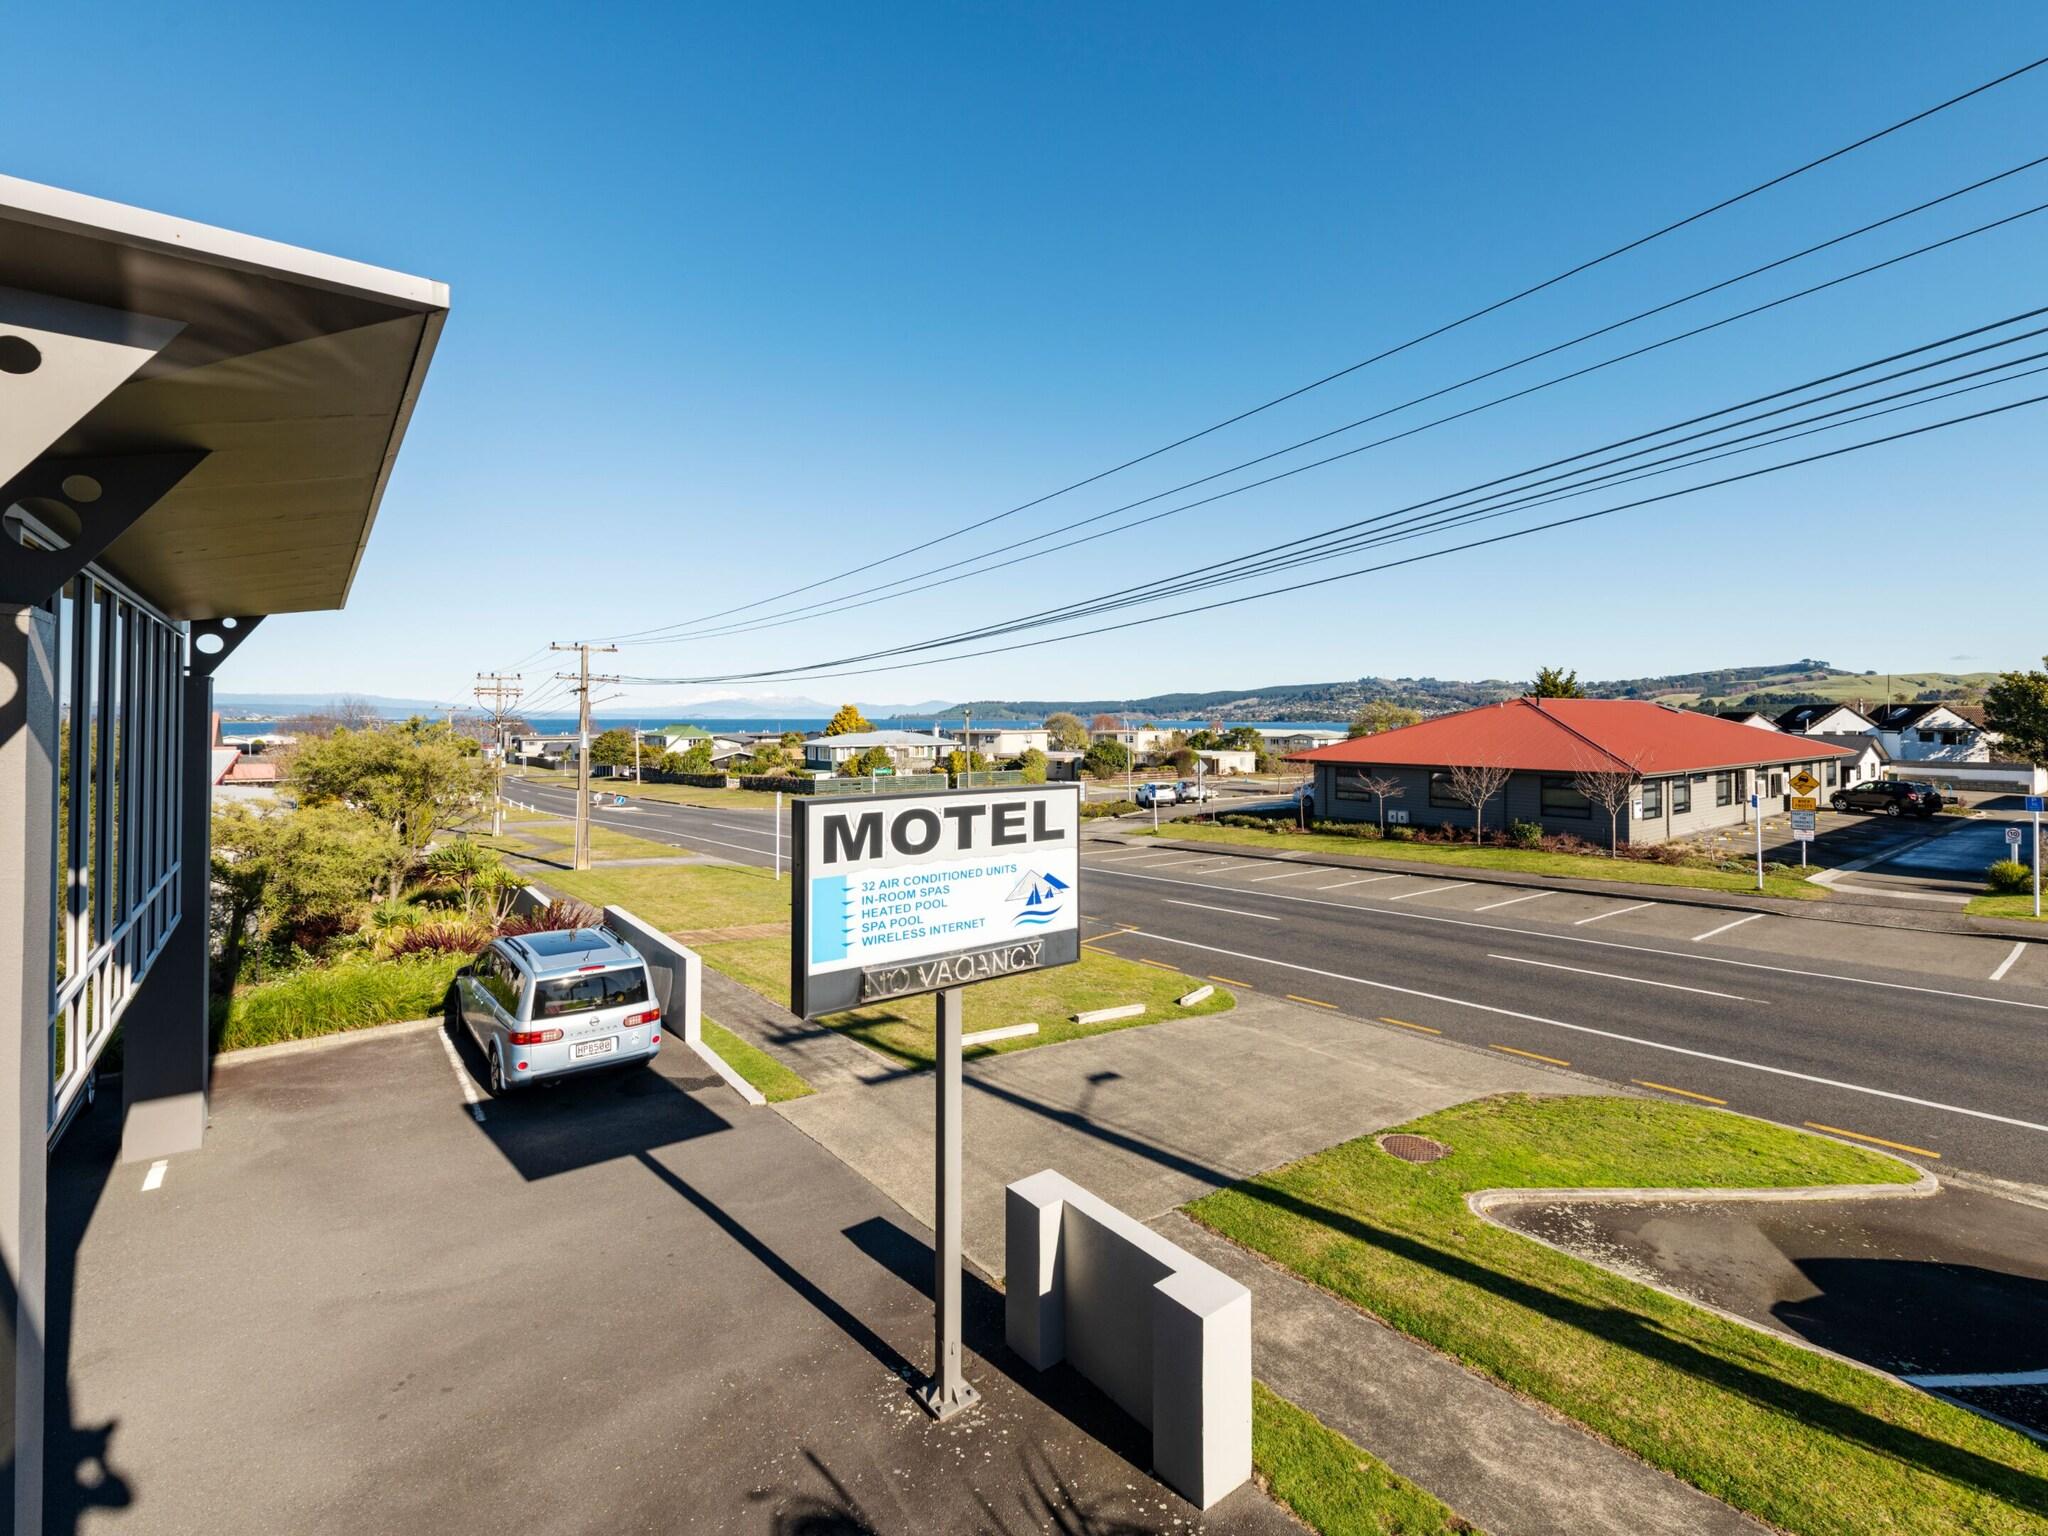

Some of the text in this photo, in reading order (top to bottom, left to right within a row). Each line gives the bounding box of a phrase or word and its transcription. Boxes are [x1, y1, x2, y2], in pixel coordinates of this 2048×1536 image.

[823, 800, 1065, 865] MOTEL
[861, 864, 1017, 892] 32 AIR CONDITIONED UNITS
[861, 885, 950, 905] IN-ROOM SPAS
[861, 899, 948, 919] HEATED POOL
[861, 915, 924, 933] SPA POOL
[861, 918, 986, 946] WIRELESS INTERNET
[866, 943, 1042, 996] NO VACANCY
